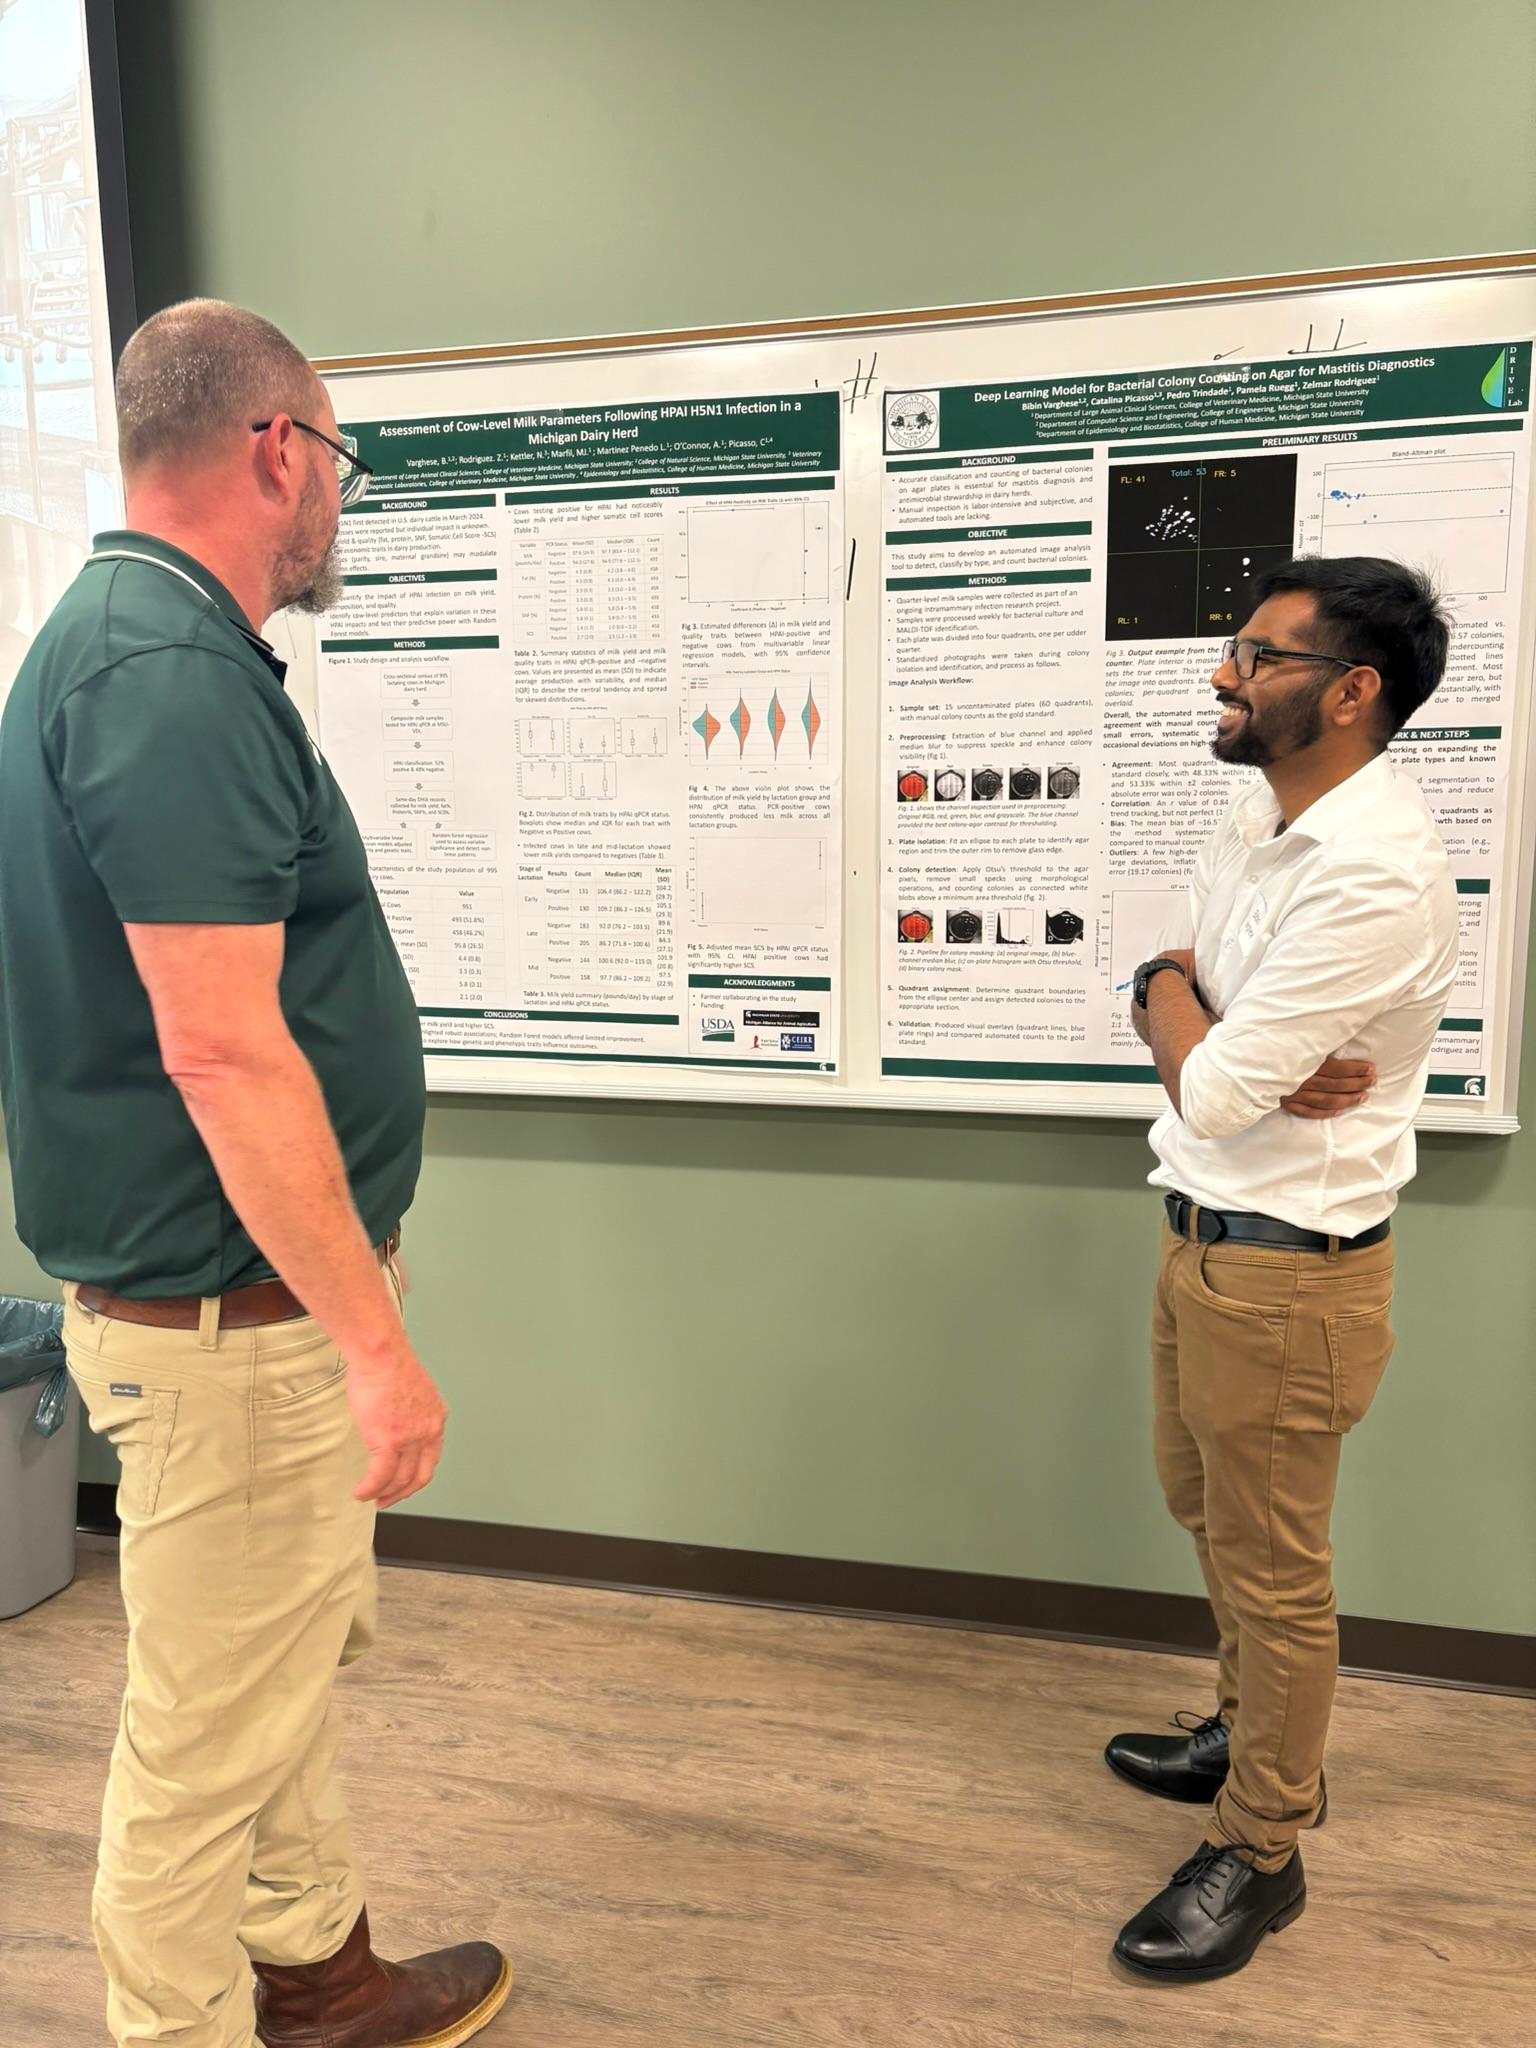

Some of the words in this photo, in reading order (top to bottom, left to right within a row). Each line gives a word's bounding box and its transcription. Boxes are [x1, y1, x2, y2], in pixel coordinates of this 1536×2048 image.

[975, 393, 1001, 402] Deep
[1004, 389, 1049, 399] Learning
[1052, 384, 1086, 395] Model
[1089, 383, 1105, 393] for
[1108, 378, 1155, 391] Bacterial
[1158, 376, 1196, 387] Colony
[1199, 372, 1249, 384] Counting
[1269, 369, 1296, 380] Agar
[1298, 366, 1316, 376] for
[1319, 363, 1364, 374] Mastitis
[1368, 358, 1434, 371] Diagnostics
[1091, 397, 1123, 405] Catalina
[1236, 385, 1266, 394] Pamela
[380, 424, 440, 436] Assessment
[443, 421, 454, 432] of
[457, 418, 510, 431] Cow-Level
[514, 416, 537, 428] Milk
[540, 415, 602, 425] Parameters
[605, 409, 658, 421] Following
[661, 406, 687, 417] HPAI
[691, 405, 722, 416] H5N1
[726, 402, 776, 414] Infection
[781, 401, 791, 411] in
[794, 402, 801, 410] a
[529, 432, 577, 444] Michigan
[580, 430, 609, 441] Dairy
[612, 427, 638, 438] Herd
[1262, 435, 1320, 446] PRELIMINARY
[1322, 433, 1358, 443] RESULTS
[406, 459, 440, 467] Varghese,
[962, 456, 1016, 466] BACKGROUND
[382, 501, 427, 510] BACKGROUND
[968, 530, 1008, 538] OBJECTIVE
[968, 576, 1007, 585] METHODS
[1471, 695, 1500, 703] merged
[484, 1011, 529, 1019] CONCLUSIONS
[702, 1019, 735, 1029] USDA
